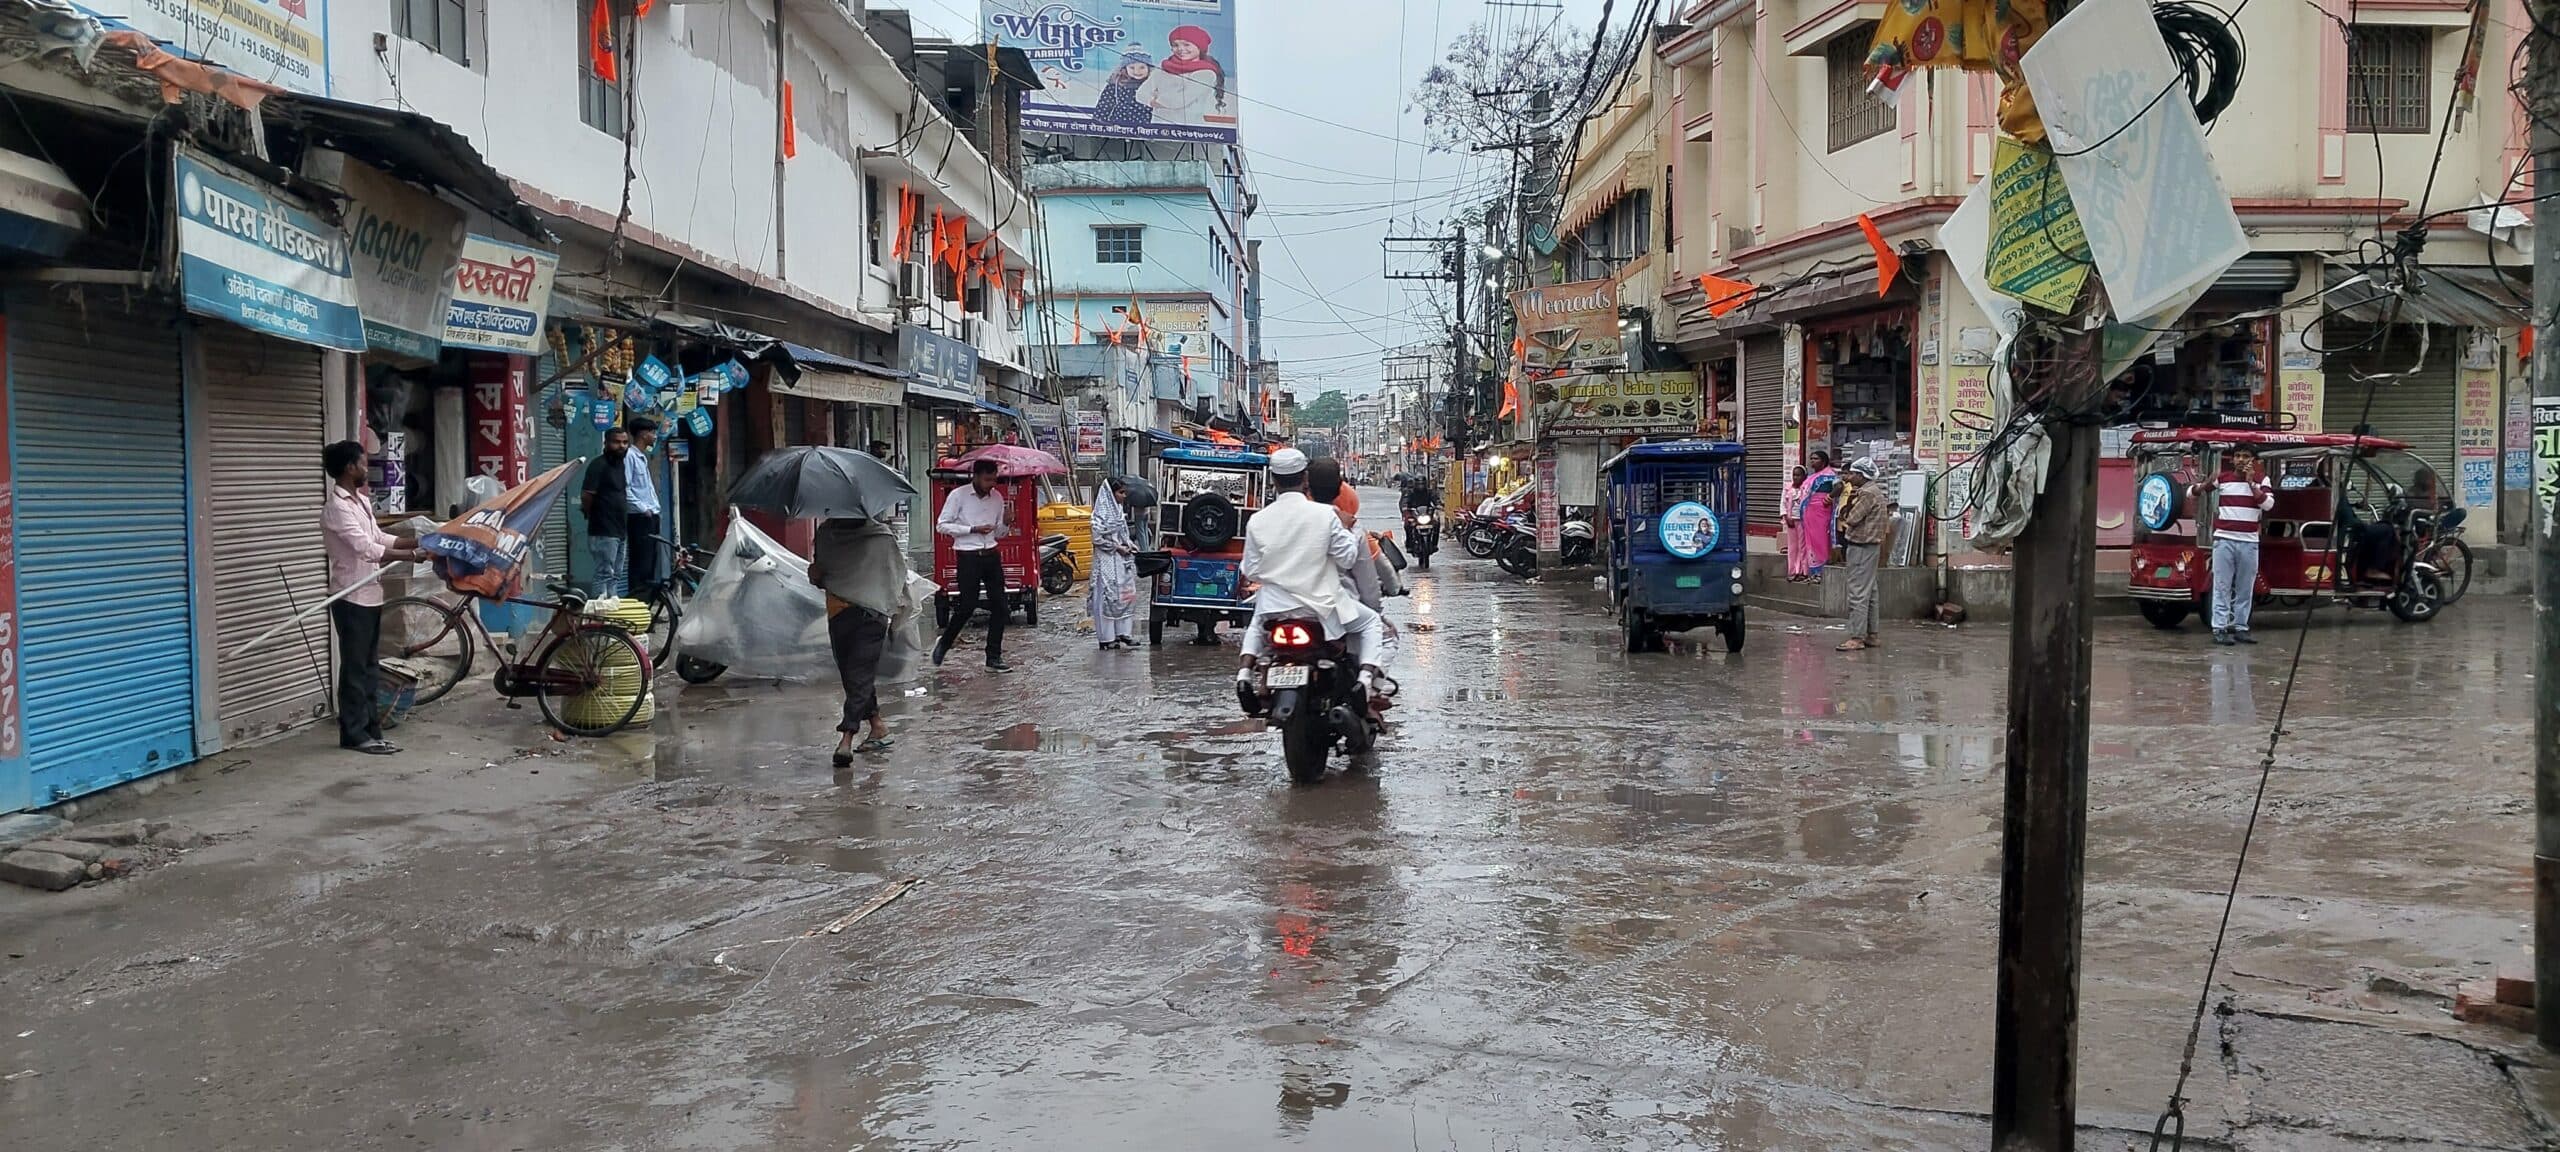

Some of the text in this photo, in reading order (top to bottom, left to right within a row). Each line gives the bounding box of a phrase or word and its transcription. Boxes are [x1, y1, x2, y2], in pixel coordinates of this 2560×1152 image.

[991, 4, 1126, 66] Winter
[240, 38, 257, 54] +91
[1034, 48, 1076, 59] ARRIVAL
[202, 186, 330, 268] पारस मेडिकल
[350, 207, 432, 275] Jaquar
[381, 264, 427, 295] LIGHTING
[456, 255, 536, 303] रस्वती
[2049, 278, 2062, 288] NO
[2043, 281, 2077, 300] PARKING
[1518, 287, 1612, 320] Moments
[1958, 378, 1985, 388] कोचिंग
[2287, 381, 2312, 391] कोचिंग
[1559, 379, 1695, 400] Moment's Cake Shop
[1957, 388, 1986, 399] ऑफिस
[1956, 399, 1986, 409] के लिए
[2298, 402, 2314, 411] लिए
[2220, 413, 2259, 425] THUKRAL
[2264, 433, 2306, 443] THUKRAL
[2505, 460, 2529, 468] BPSC
[2464, 471, 2493, 480] BPSC
